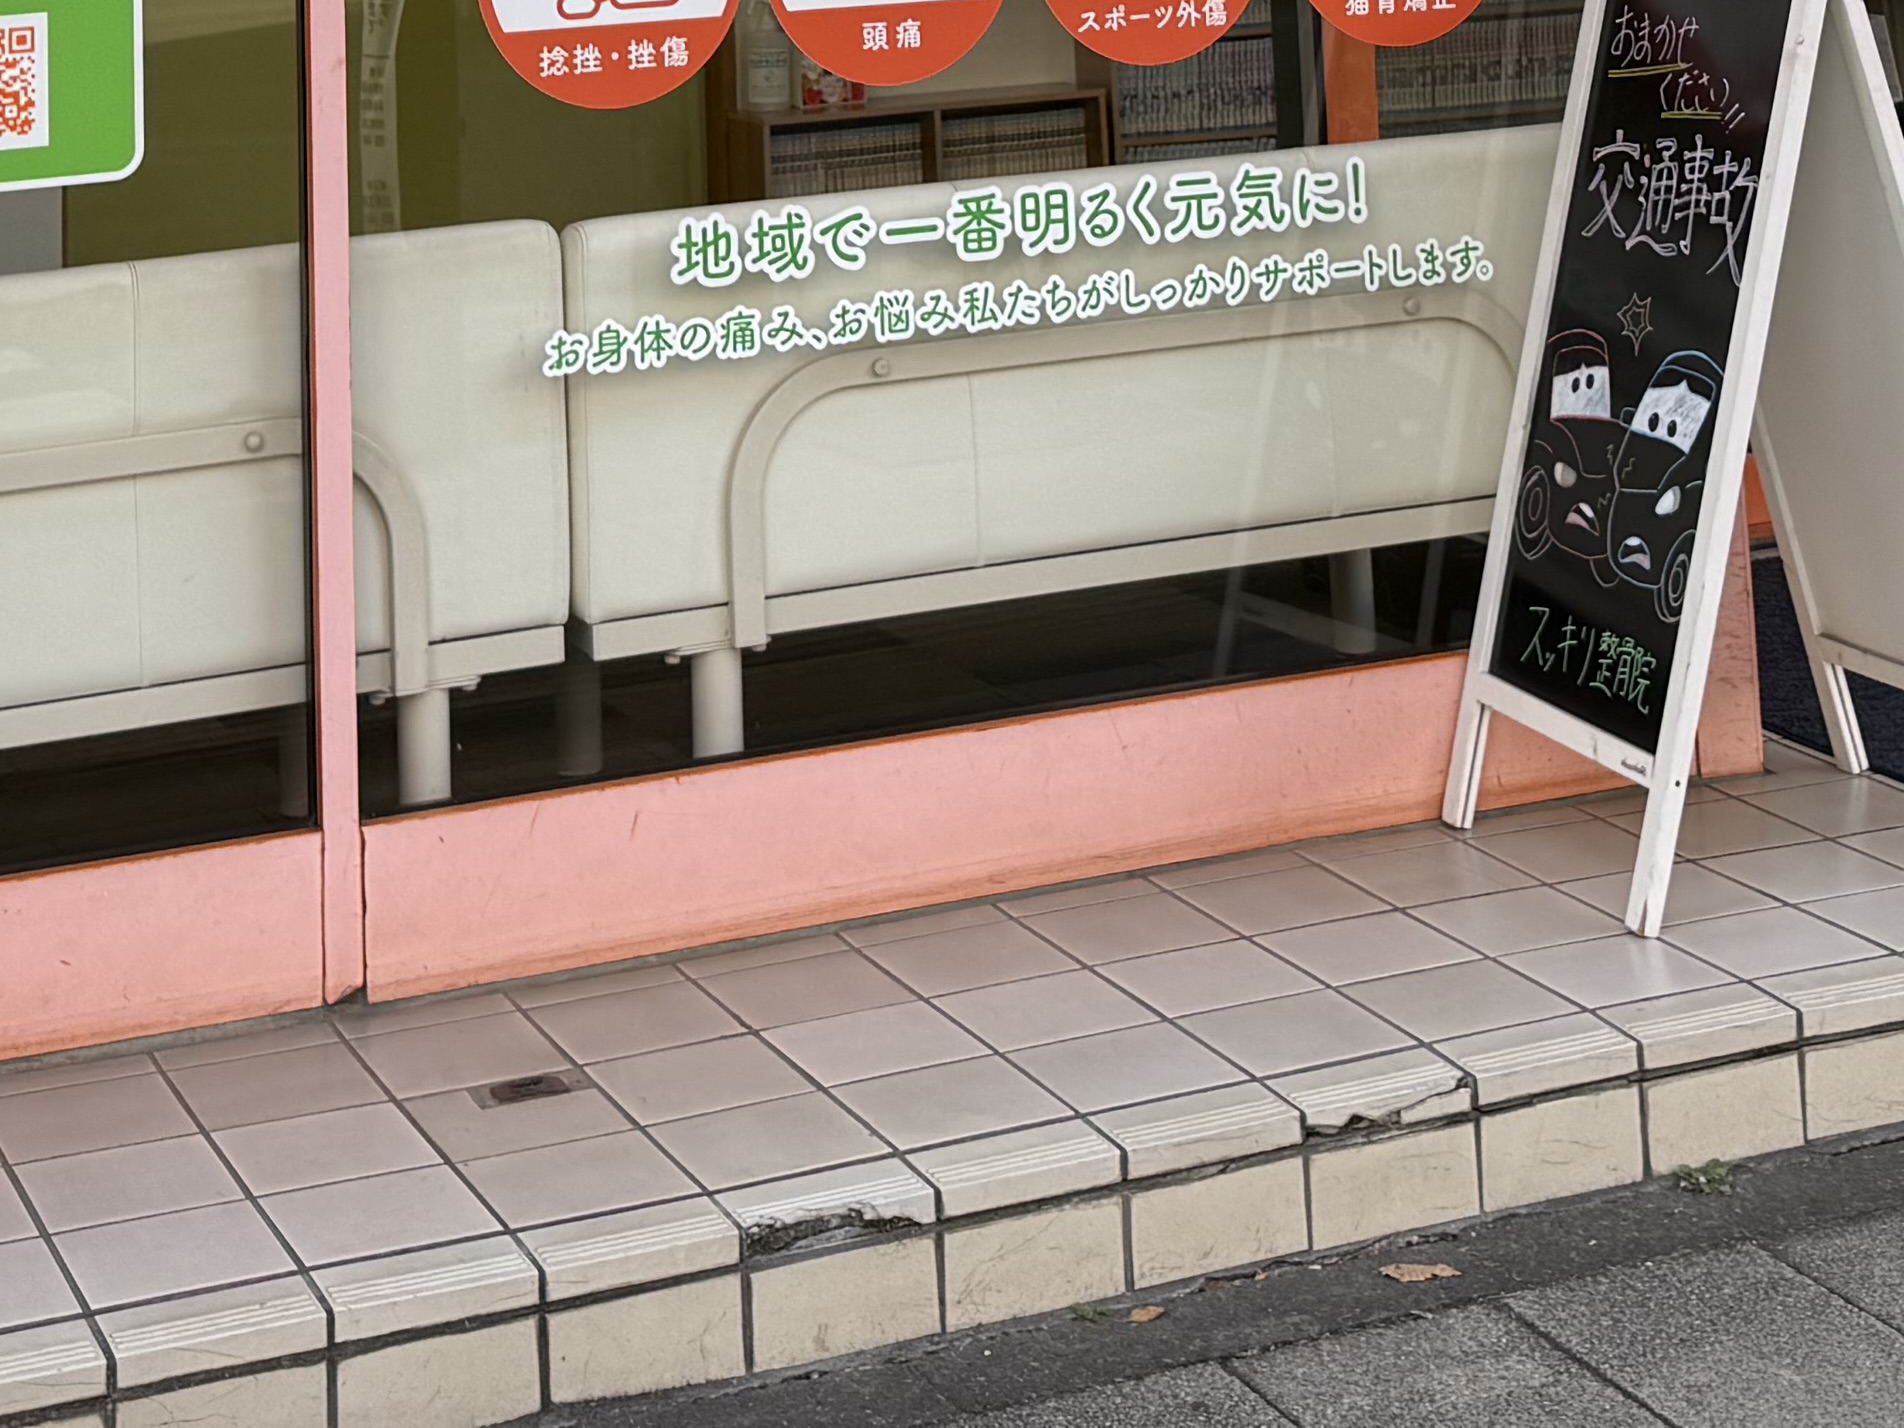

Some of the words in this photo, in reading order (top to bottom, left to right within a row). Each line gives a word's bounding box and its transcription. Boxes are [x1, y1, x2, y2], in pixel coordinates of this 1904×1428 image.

[537, 40, 690, 79] 捻挫・挫傷
[861, 18, 923, 52] 頭痛
[1610, 4, 1699, 69] おまかせ
[670, 157, 1367, 289] 地域で一番明るく元気に!
[1581, 129, 1759, 288] 交通事故
[542, 240, 1495, 379] お身体の痛み、お悩み私たちがしっかりサポートします。
[1520, 606, 1657, 715] スッキリ整骨院
